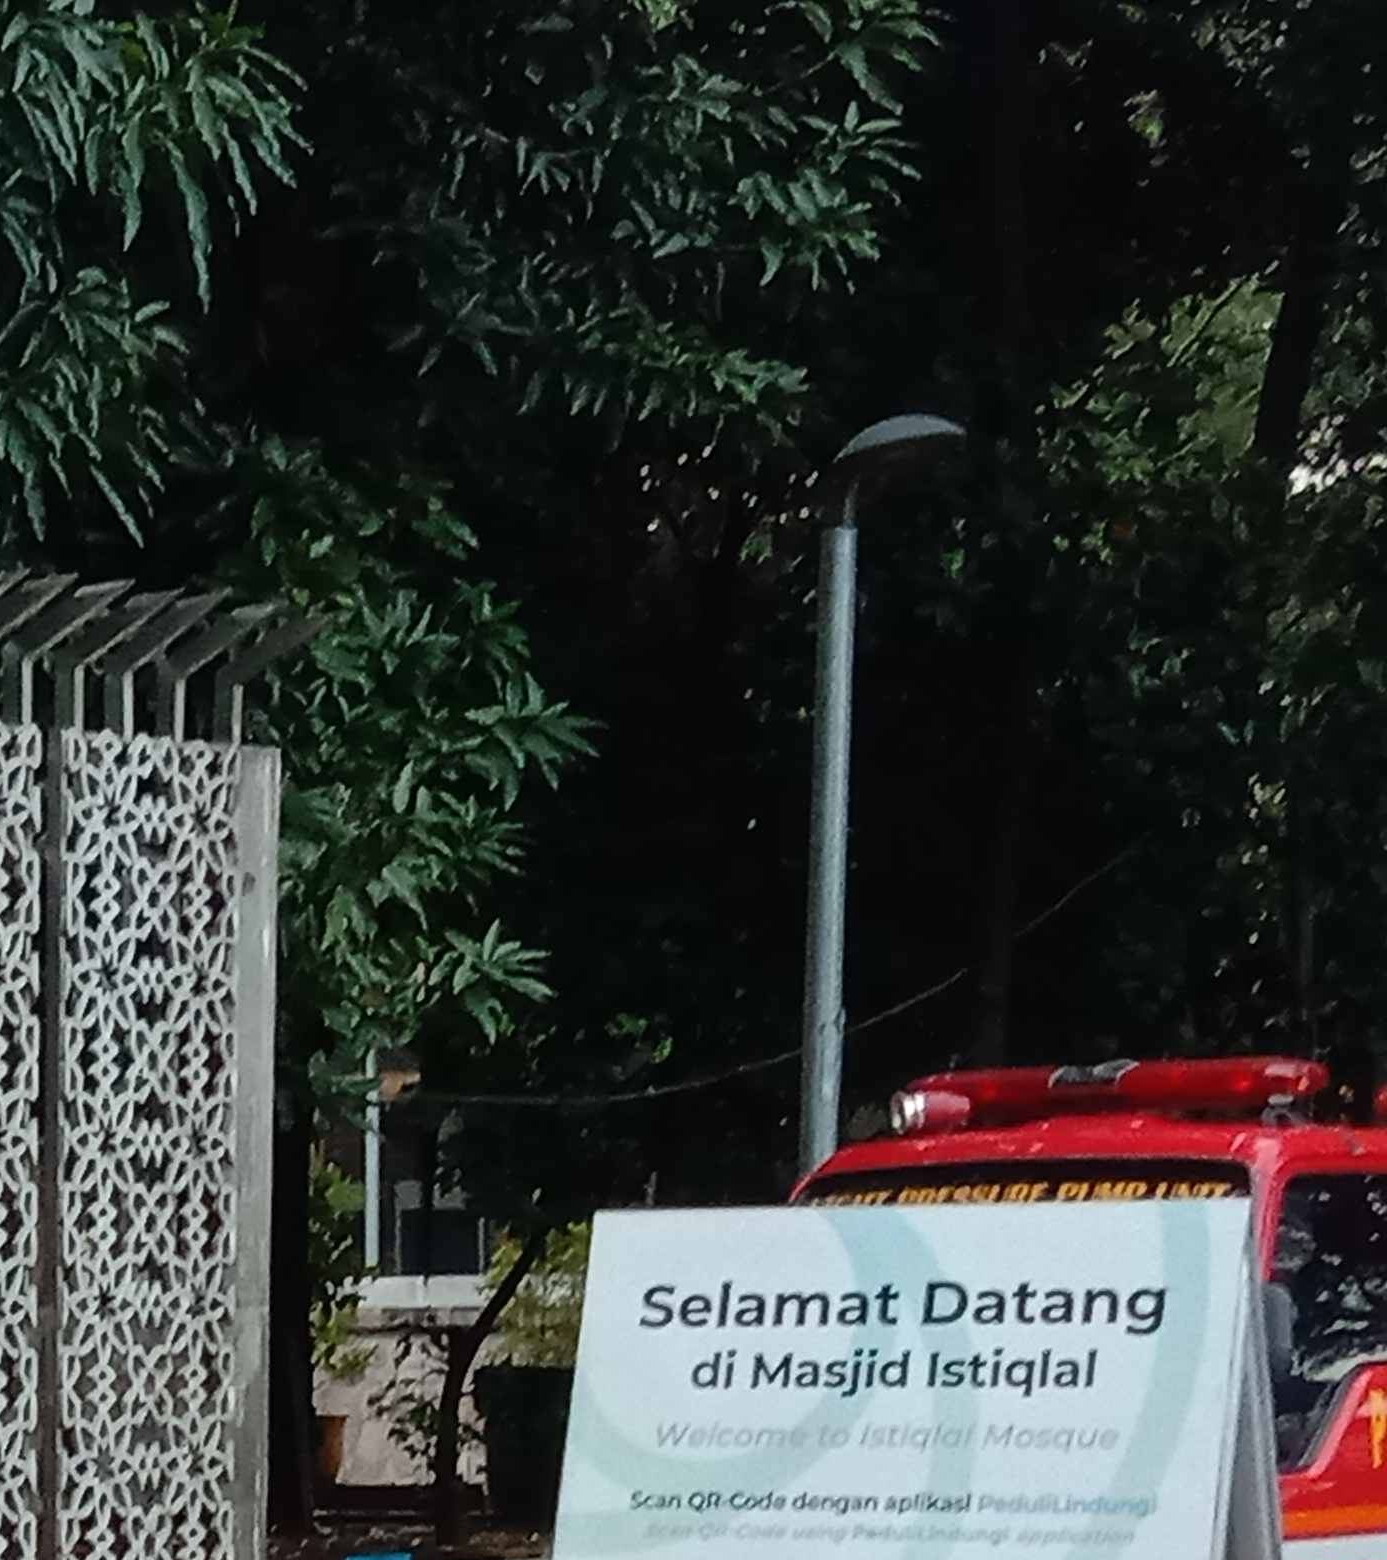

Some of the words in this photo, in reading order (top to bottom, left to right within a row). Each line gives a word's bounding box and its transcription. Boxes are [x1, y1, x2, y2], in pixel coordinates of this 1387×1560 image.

[639, 1281, 900, 1329] Selamat
[921, 1281, 1169, 1336] Datang
[691, 1349, 736, 1390] di
[751, 1349, 912, 1398] Masjid
[927, 1348, 1098, 1397] Istiqlal
[655, 1421, 808, 1449] Welcome
[817, 1423, 850, 1449] to
[860, 1421, 973, 1455] Istiqlal
[980, 1424, 1121, 1455] Mosque
[630, 1490, 681, 1510] Scan
[791, 1491, 878, 1515] dengan
[883, 1492, 971, 1515] aplikasi
